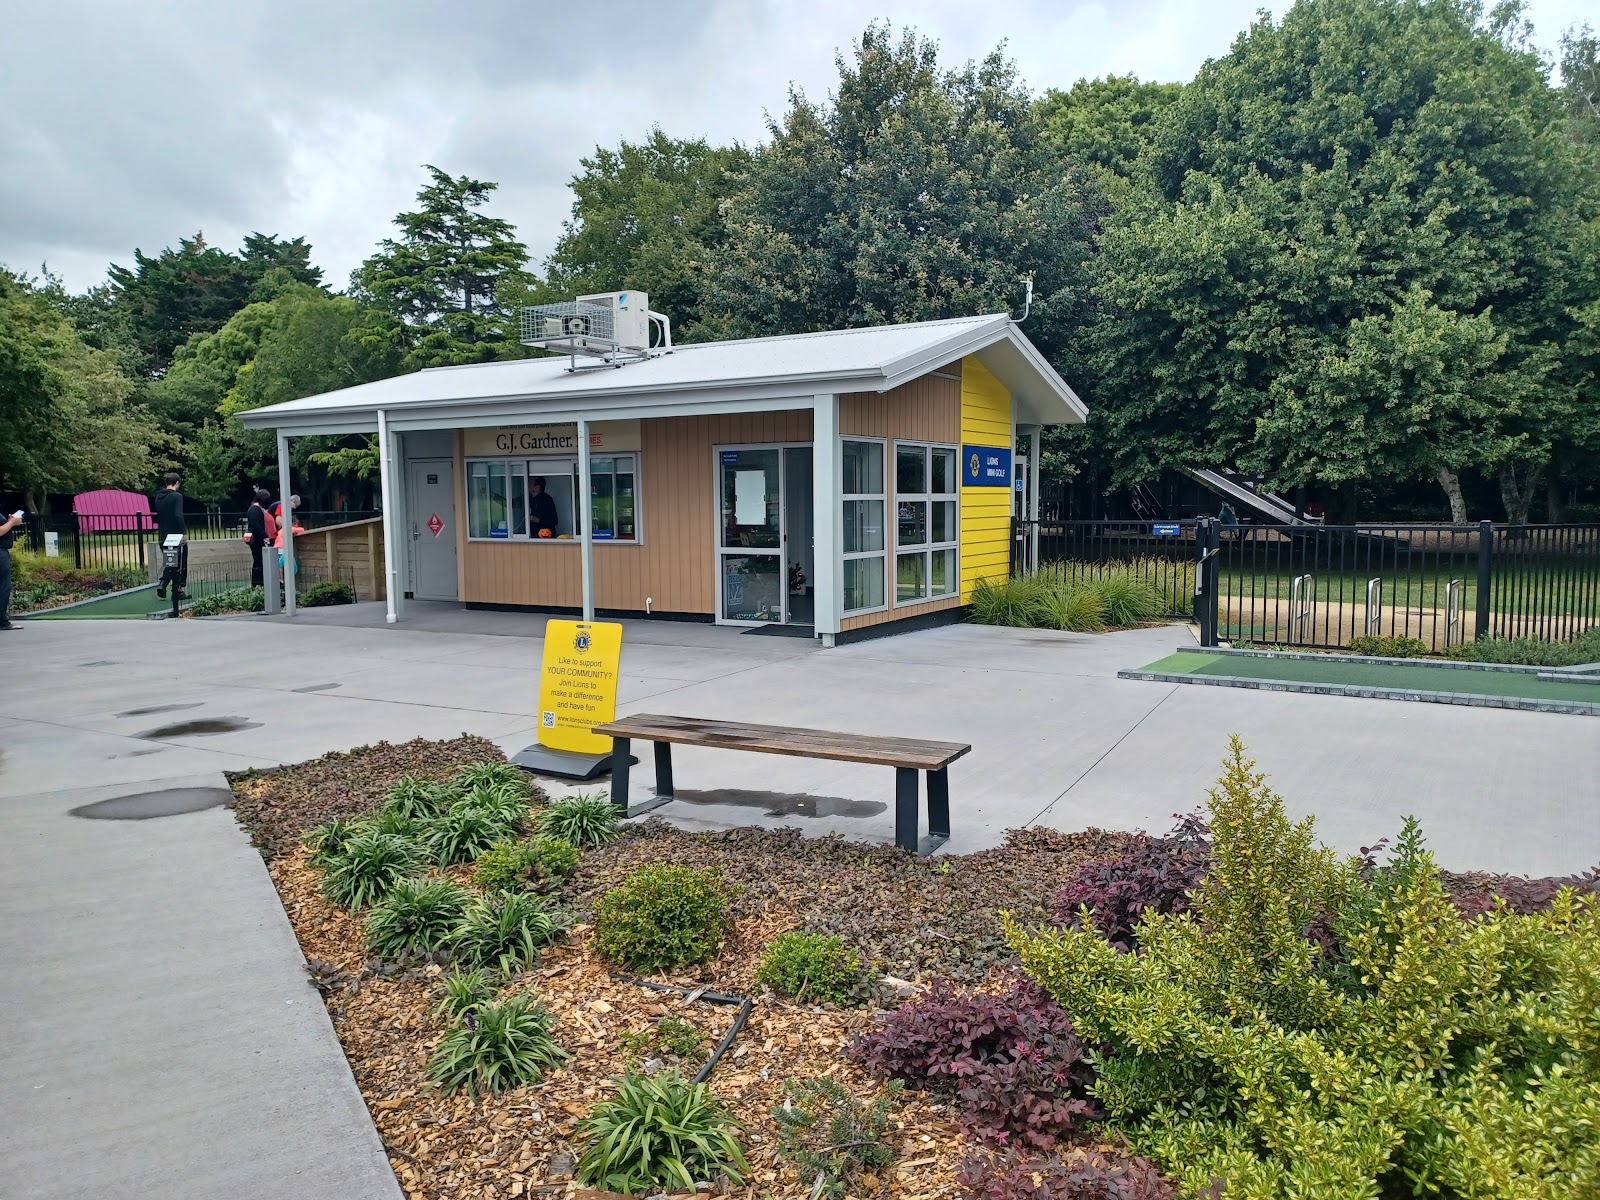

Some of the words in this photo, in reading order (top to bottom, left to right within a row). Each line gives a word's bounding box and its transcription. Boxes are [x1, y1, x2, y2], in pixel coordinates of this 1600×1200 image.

[496, 433, 517, 453] G.J.
[520, 432, 573, 450] Gardner.
[579, 660, 602, 668] support
[547, 667, 565, 675] YOUR
[567, 669, 612, 679] COMMUNITY?
[559, 679, 572, 687] Join
[572, 680, 589, 688] Lions
[590, 682, 597, 690] to
[551, 690, 568, 698] make
[574, 692, 603, 701] difference
[569, 702, 585, 711] have
[585, 703, 596, 712] fun
